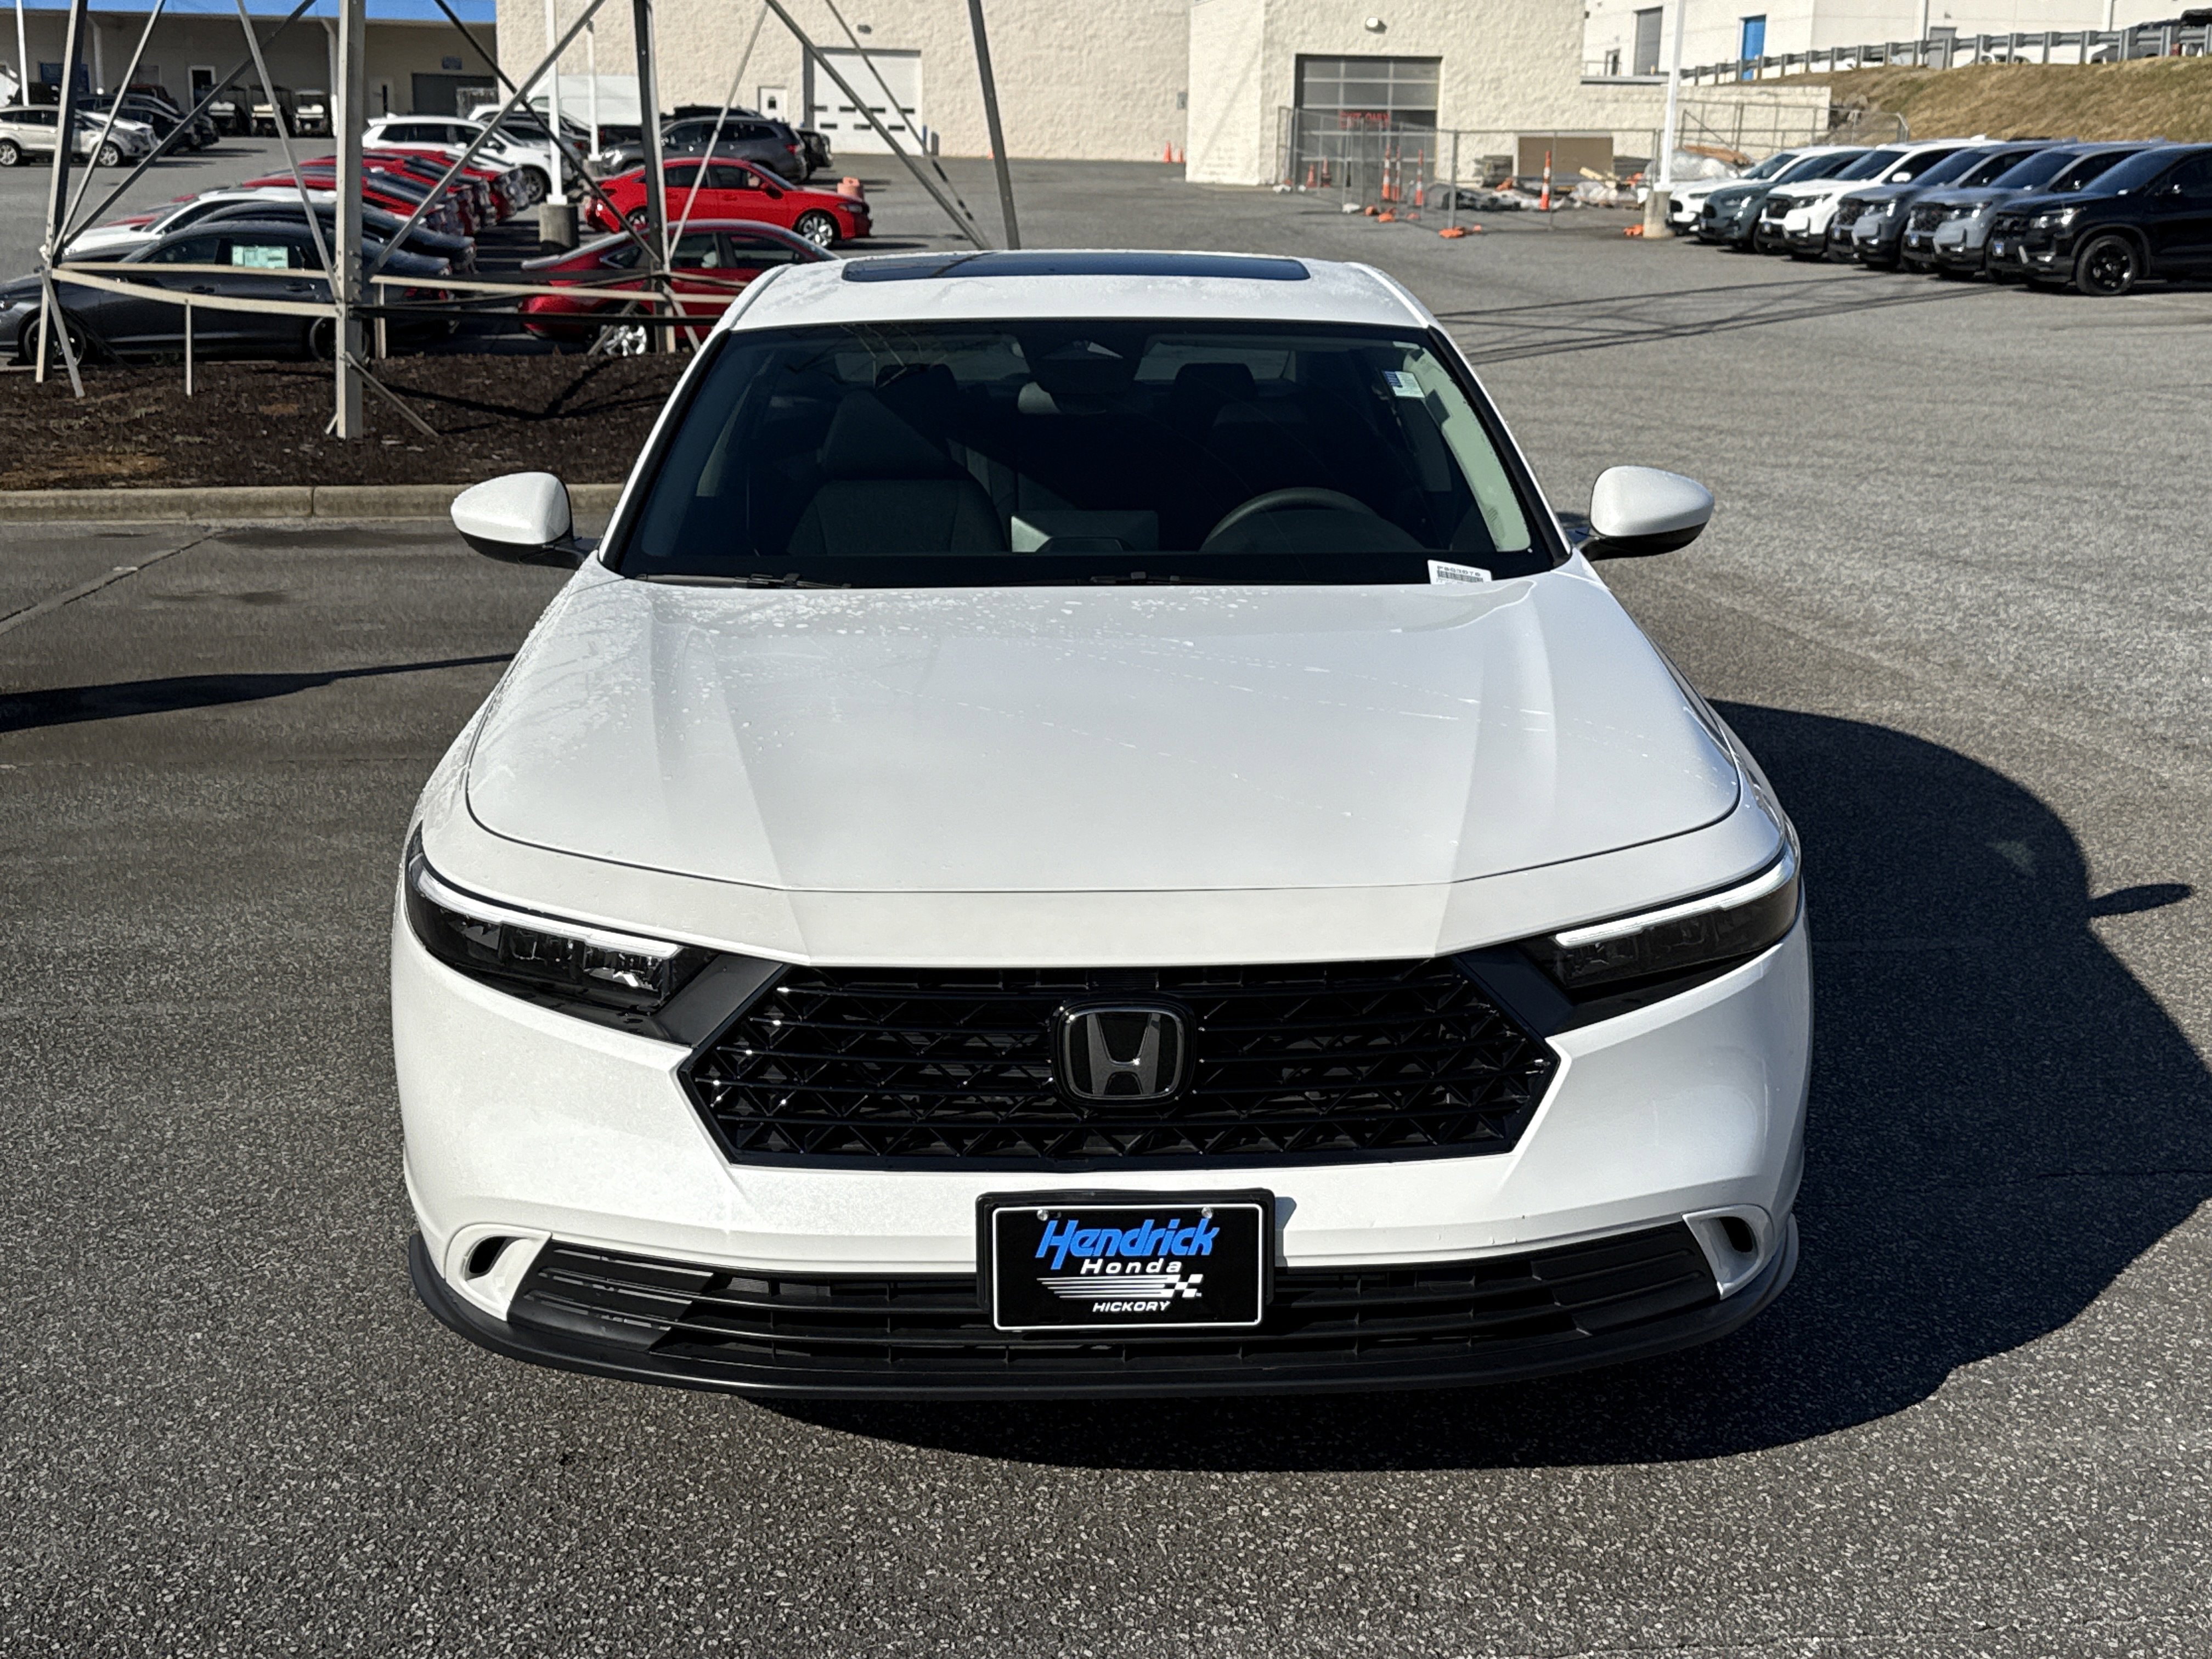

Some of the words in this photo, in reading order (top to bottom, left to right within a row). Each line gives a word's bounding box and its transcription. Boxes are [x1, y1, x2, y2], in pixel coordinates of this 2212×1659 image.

[1035, 1218, 1220, 1270] Hendrick
[1080, 1258, 1182, 1274] Honda
[1092, 1300, 1171, 1312] HICKORY
